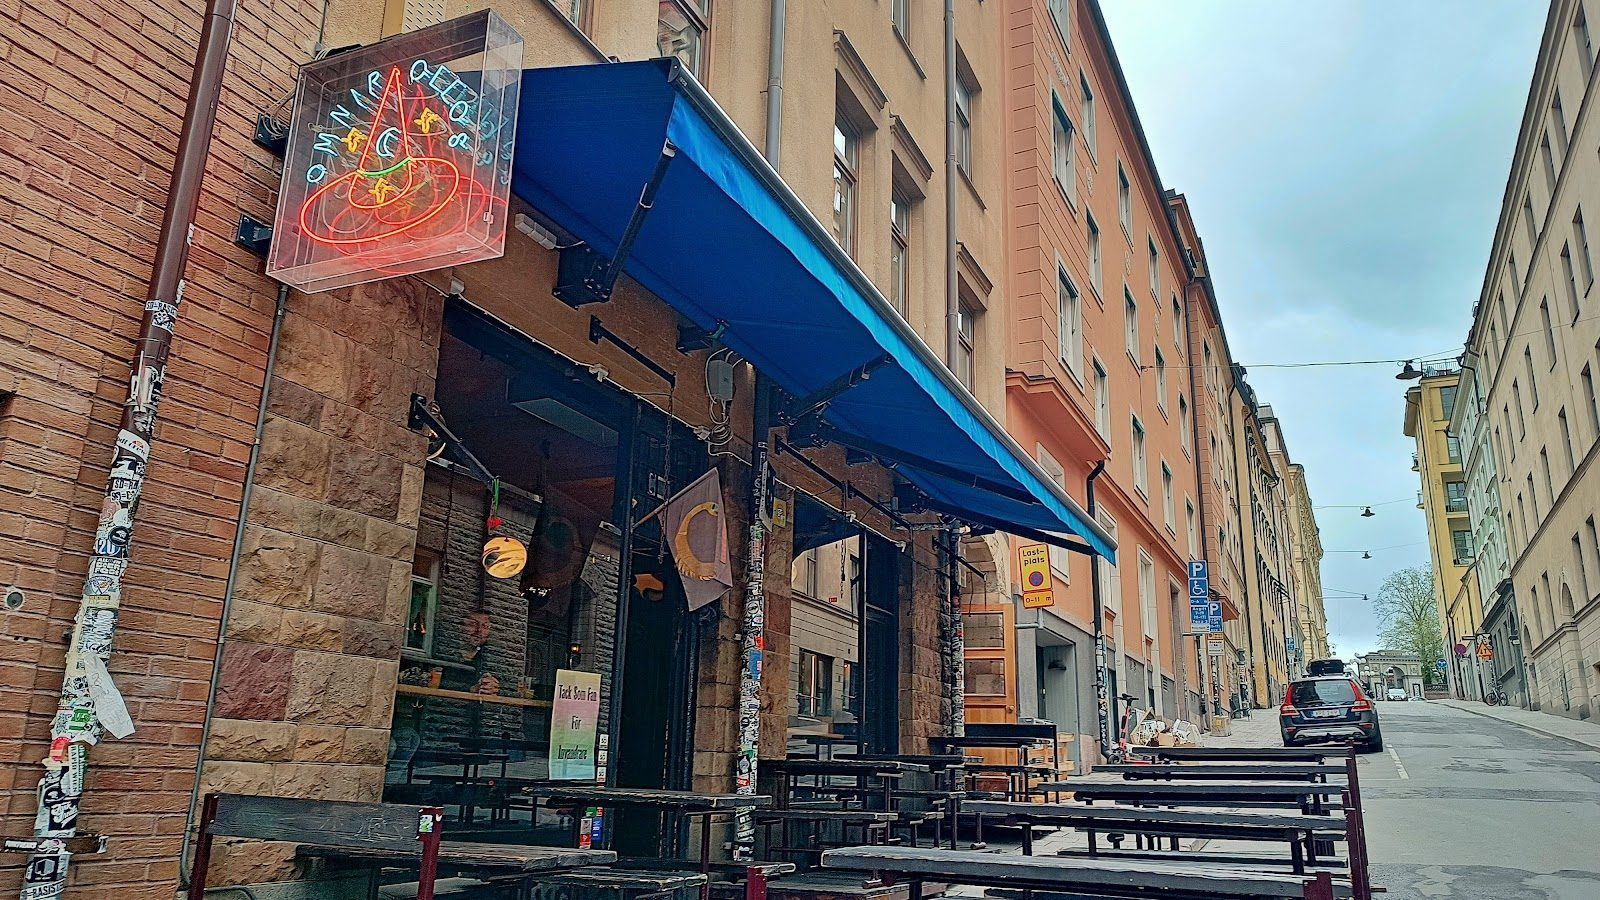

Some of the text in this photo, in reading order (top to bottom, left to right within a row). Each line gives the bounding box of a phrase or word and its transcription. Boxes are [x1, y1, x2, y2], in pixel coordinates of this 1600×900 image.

[1022, 548, 1045, 557] Last-
[1024, 557, 1045, 566] plats
[1192, 562, 1204, 577] P
[1210, 603, 1219, 616] P
[558, 684, 597, 701] Tack Som Fan
[571, 715, 582, 730] För
